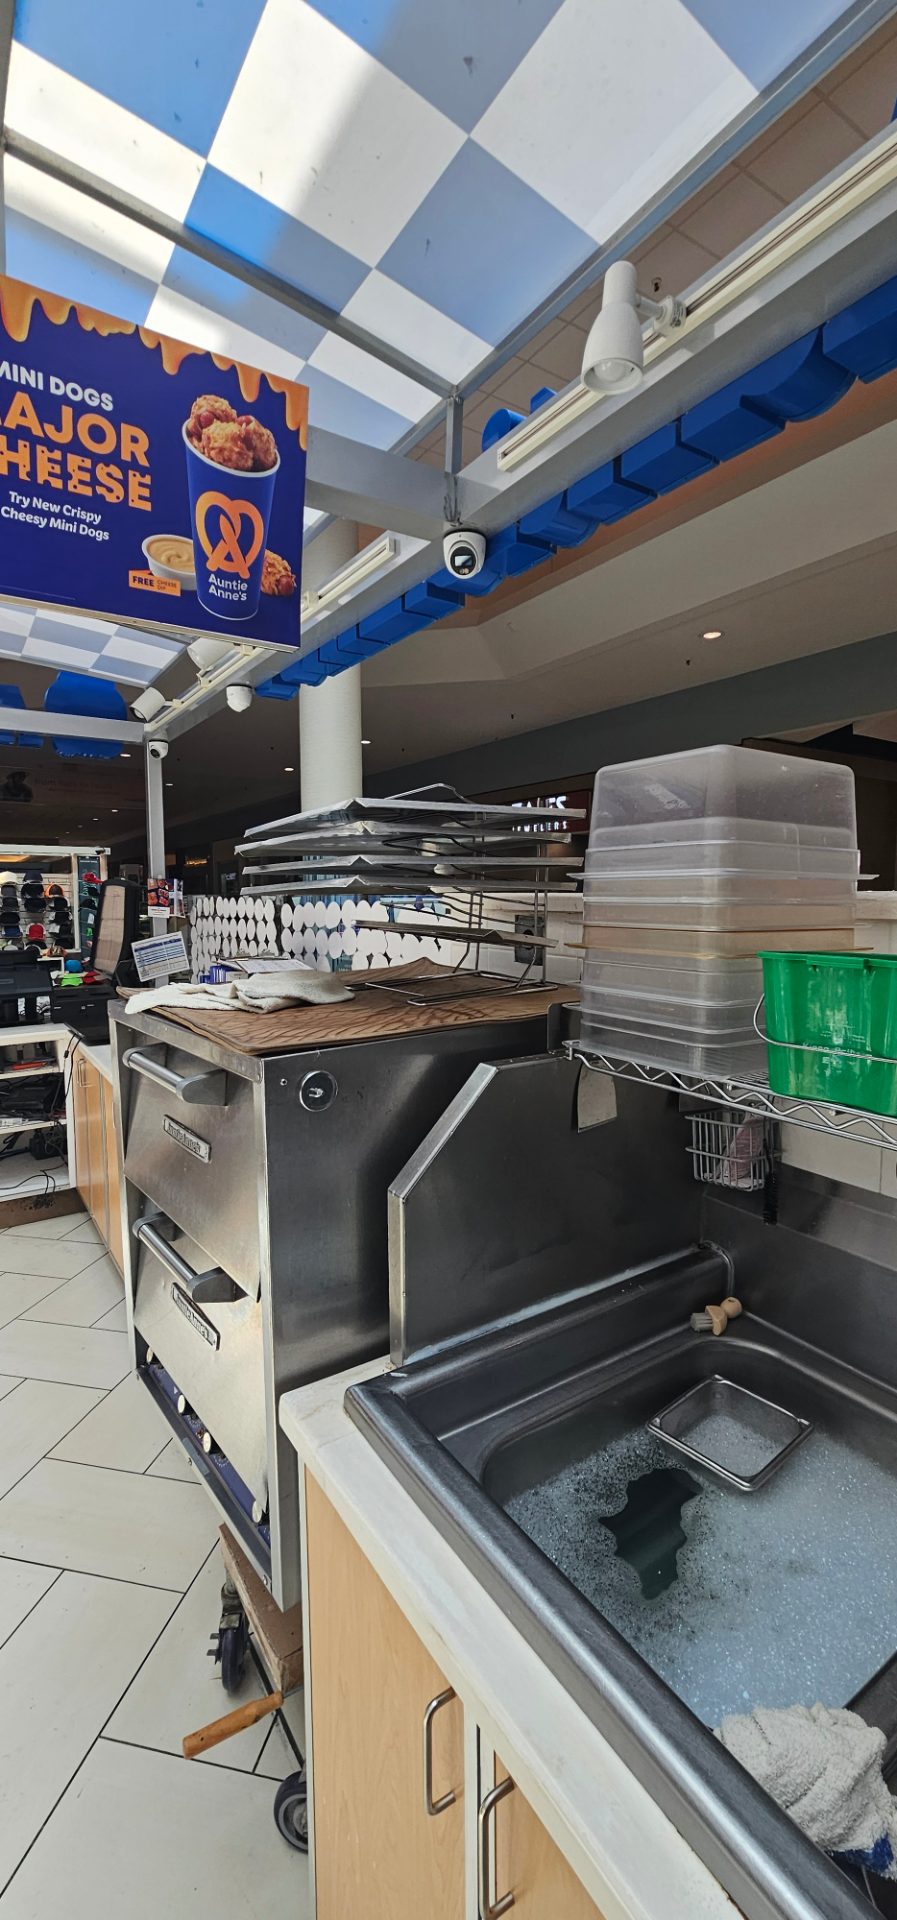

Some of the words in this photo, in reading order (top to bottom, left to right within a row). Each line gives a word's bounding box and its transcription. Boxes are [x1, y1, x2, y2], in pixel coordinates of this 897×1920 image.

[50, 375, 114, 411] DOGS
[0, 391, 150, 468] AJOR
[0, 434, 151, 512] HEESE
[0, 506, 47, 529] Cheesy
[49, 517, 77, 533] Mini
[79, 524, 110, 541] Dogs
[9, 490, 30, 509] Try
[32, 496, 60, 513] New
[62, 504, 102, 525] Crispy
[132, 575, 155, 587] FREE
[208, 573, 248, 591] Auntie
[208, 586, 248, 601] Anne's
